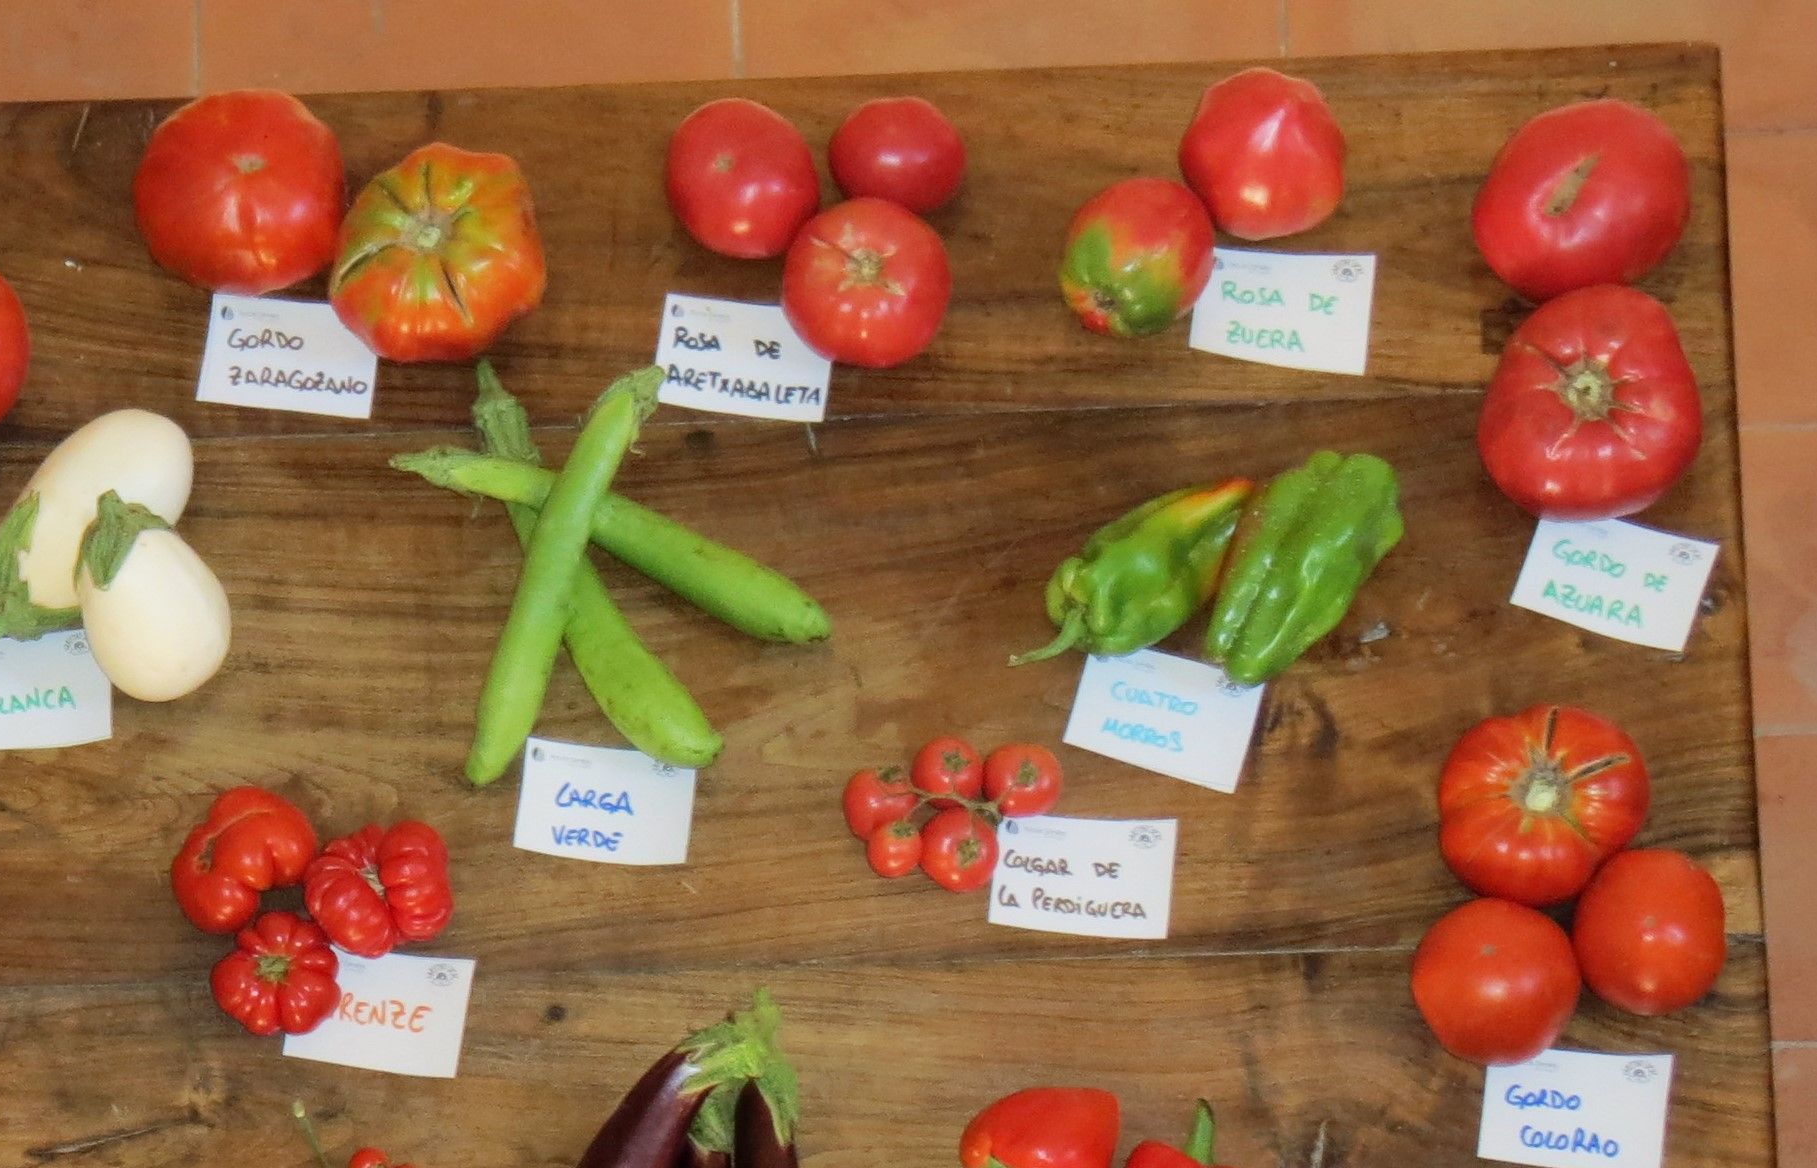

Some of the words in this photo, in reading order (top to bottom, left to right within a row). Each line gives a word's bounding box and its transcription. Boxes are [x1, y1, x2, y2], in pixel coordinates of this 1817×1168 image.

[1221, 279, 1286, 308] ROSA
[1308, 292, 1340, 315] DE
[227, 328, 304, 351] GORDO
[673, 326, 721, 352] ROSA
[753, 338, 781, 359] DE
[1226, 320, 1305, 353] ZUERA
[228, 366, 368, 395] ZARAGOZANO
[666, 363, 821, 406] ARETXABALETA
[1552, 538, 1626, 581] GORDO
[1644, 569, 1669, 593] DE
[1541, 580, 1645, 629] AZUARA
[1109, 681, 1200, 716] CUATRO
[1101, 718, 1185, 753] MORROS
[555, 782, 634, 816] LARGA
[552, 825, 624, 851] VERDE
[1003, 849, 1073, 879] COLGAR
[1093, 860, 1121, 880] DE
[997, 886, 1020, 908] LA
[1032, 889, 1148, 920] PERDIGUERA
[1505, 1084, 1583, 1111] GORDO
[1521, 1125, 1619, 1157] COLORAO
